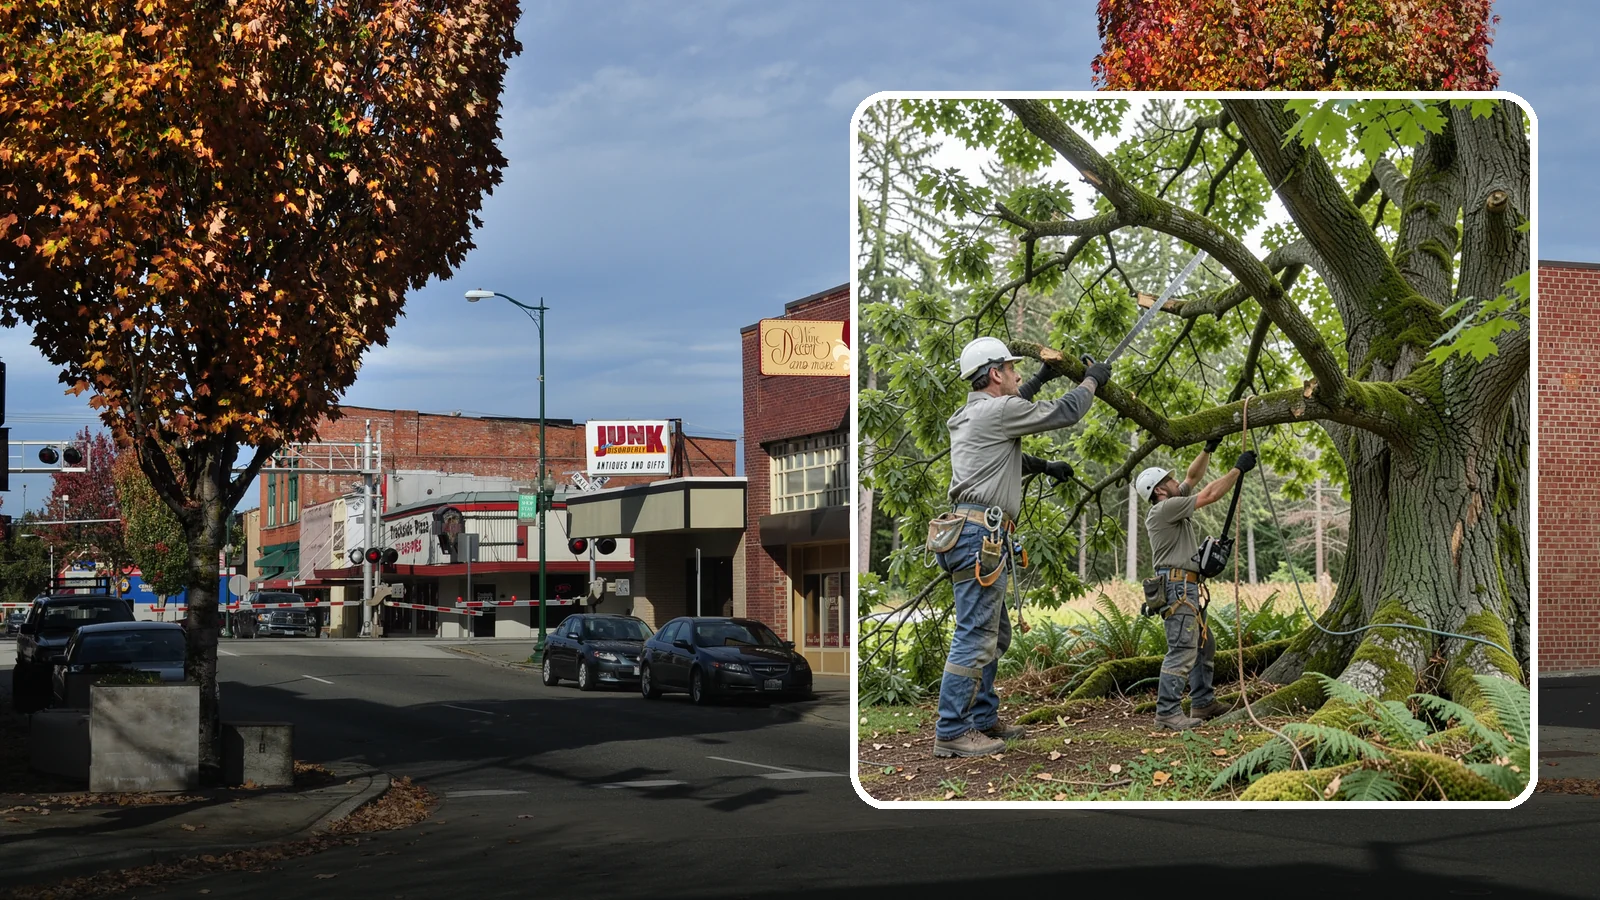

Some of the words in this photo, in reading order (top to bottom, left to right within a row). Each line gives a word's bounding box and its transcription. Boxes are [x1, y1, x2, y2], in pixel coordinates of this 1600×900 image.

[595, 425, 664, 457] JUNK
[608, 446, 646, 454] DISORDERLY
[597, 461, 628, 470] ANTIQUES
[631, 461, 644, 470] AND
[647, 460, 665, 470] GIFTS
